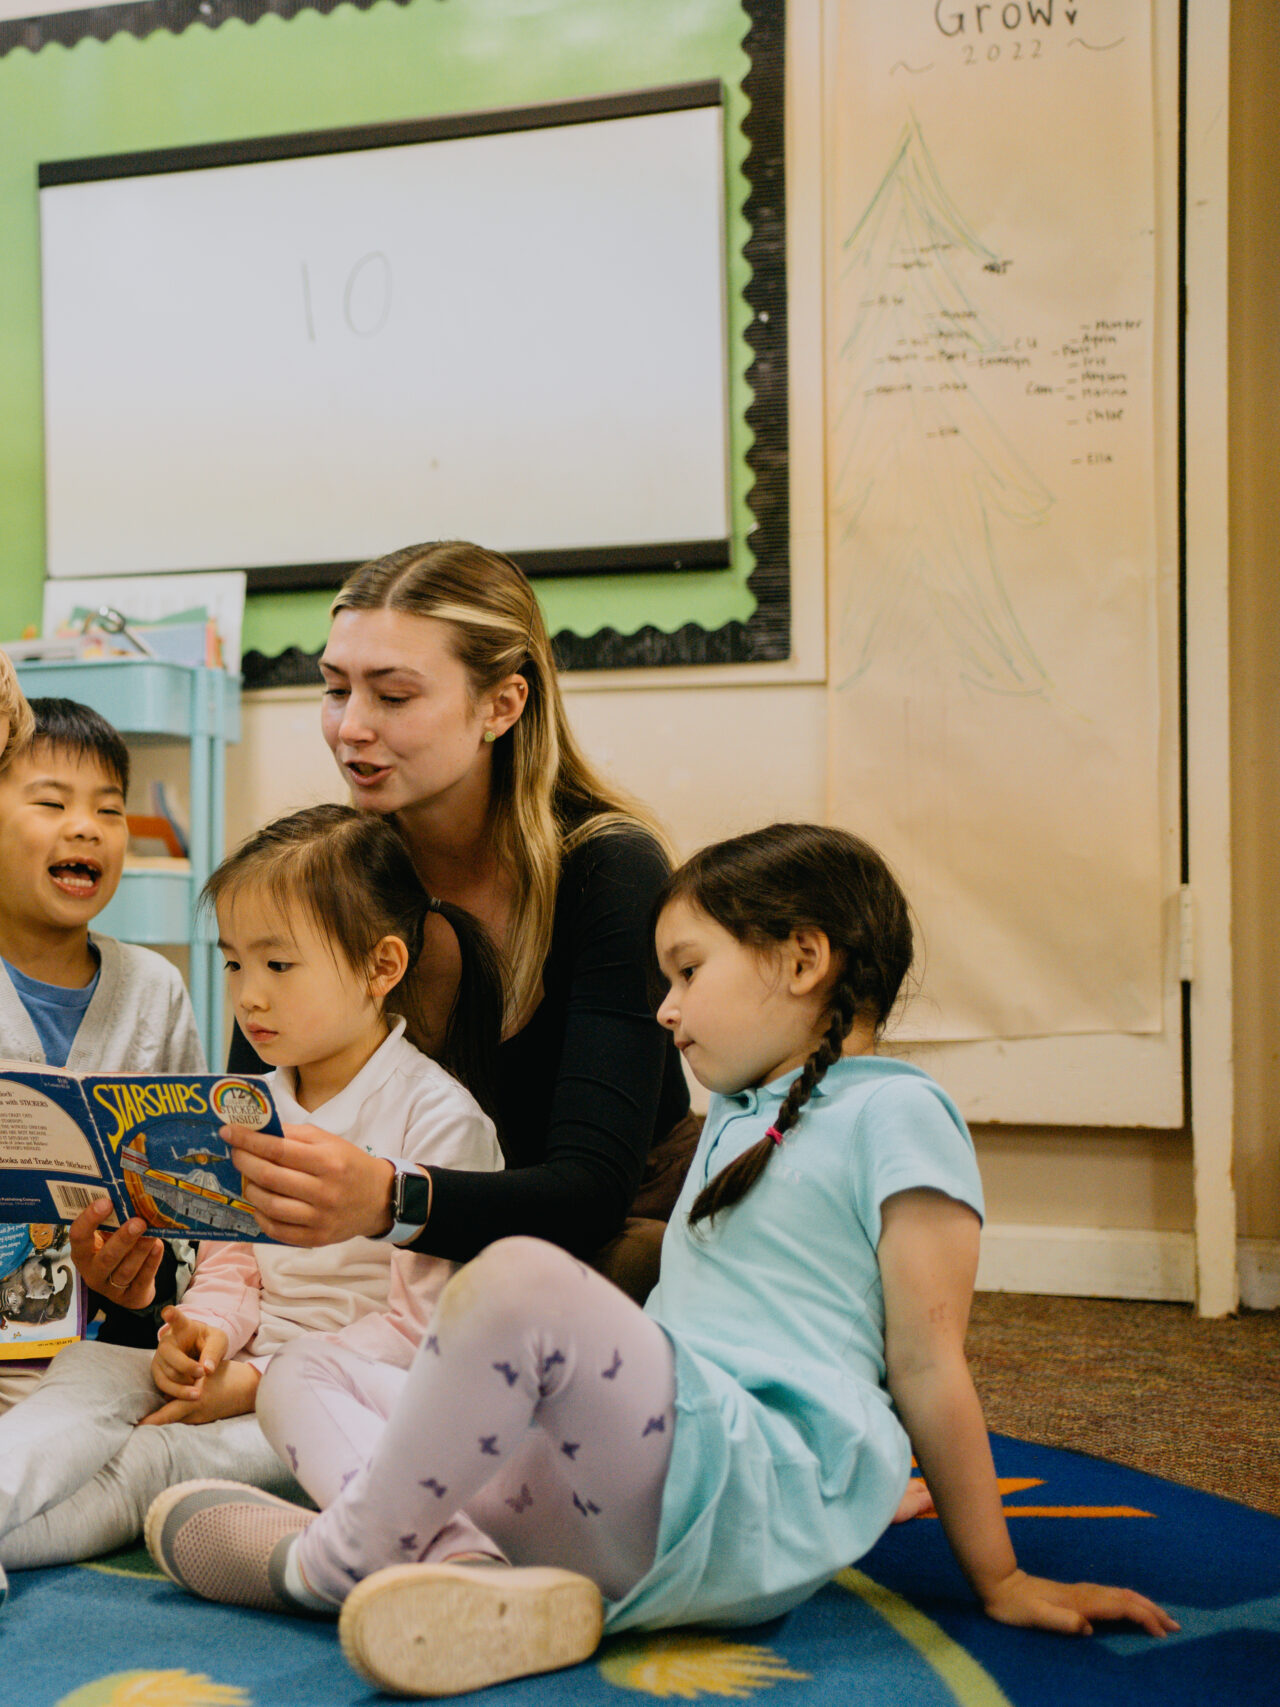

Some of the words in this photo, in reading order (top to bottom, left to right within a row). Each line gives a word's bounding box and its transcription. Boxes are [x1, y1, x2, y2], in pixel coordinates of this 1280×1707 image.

[934, 0, 1077, 37] Grow
[962, 39, 1043, 66] 2022
[300, 250, 393, 343] 10
[19, 1100, 48, 1108] STICKERS
[220, 1104, 265, 1115] STICKERS
[93, 1083, 208, 1154] STARSHIPS
[228, 1115, 263, 1126] INSIDE
[33, 1158, 53, 1166] Trade
[65, 1160, 93, 1170] Stickers!
